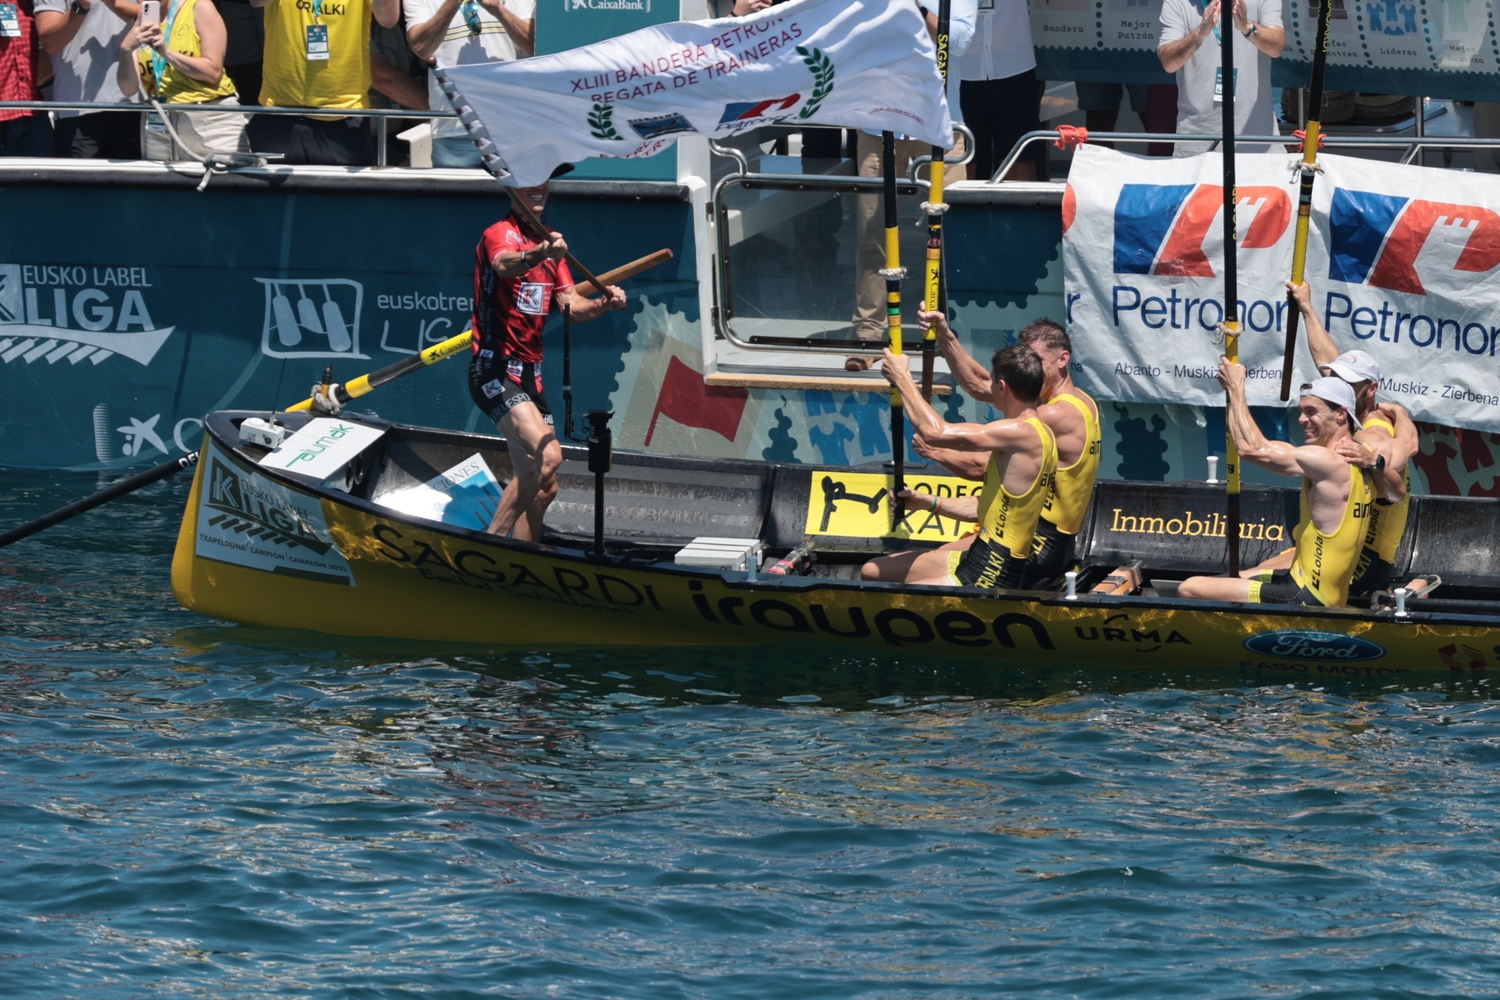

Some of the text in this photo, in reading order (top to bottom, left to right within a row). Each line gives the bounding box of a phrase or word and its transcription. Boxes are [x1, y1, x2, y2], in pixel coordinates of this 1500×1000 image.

[1043, 23, 1085, 34] Bandera
[1117, 30, 1154, 41] Patrón
[1120, 19, 1152, 31] Mejor
[591, 22, 802, 105] REGATA DE TRAINERAS
[1380, 48, 1418, 57] Líderes
[570, 73, 610, 94] XLIII
[615, 44, 708, 84] BANDERA
[22, 264, 153, 288] EUSKO LABEL
[25, 287, 156, 332] LIGA
[1114, 361, 1161, 378] Abanto
[1174, 363, 1221, 381] Muskiz
[1380, 377, 1500, 407] Muskiz Zierbena
[288, 423, 354, 467] alumak
[241, 478, 311, 521] EUSKO LABEL
[998, 494, 1010, 530] Loiola
[244, 493, 321, 542] LIGA
[200, 533, 246, 551] TXAPELDUNA
[372, 523, 664, 612] SAGARDI
[1314, 536, 1324, 578] Loiola
[1073, 622, 1193, 648] URMA
[1271, 633, 1361, 661] Ford
[1239, 661, 1310, 674] EASO
